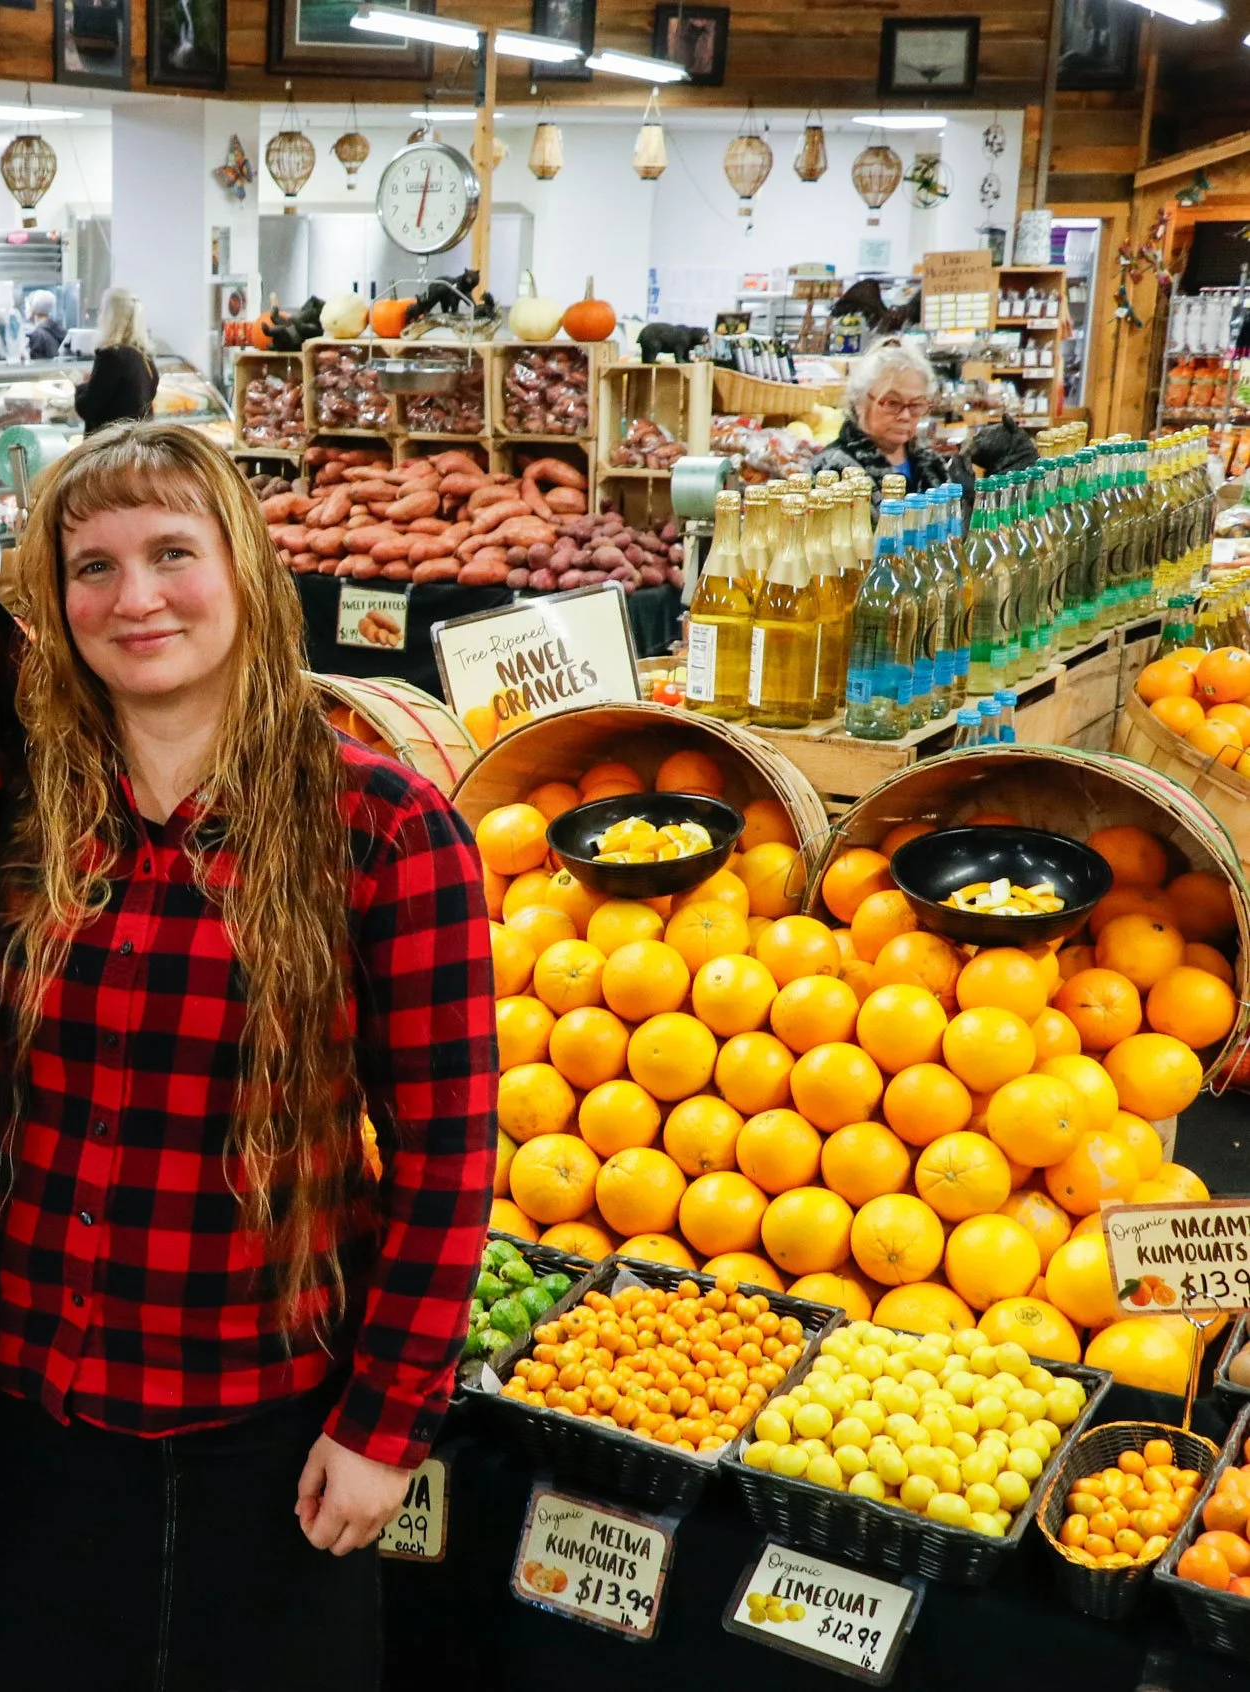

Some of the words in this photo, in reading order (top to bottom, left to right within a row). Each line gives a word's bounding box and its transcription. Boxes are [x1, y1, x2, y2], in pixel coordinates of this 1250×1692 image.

[402, 166, 410, 177] 9
[420, 159, 429, 171] 0
[438, 164, 443, 176] 1
[391, 184, 399, 195] 8
[449, 183, 457, 193] 2
[391, 204, 399, 216] 7
[449, 204, 457, 215] 3
[402, 223, 410, 233] 6
[420, 228, 427, 239] 5
[436, 221, 444, 232] 4
[341, 600, 365, 610] SWEET
[367, 600, 407, 611] POTATOES
[453, 648, 488, 671] Tree
[490, 617, 550, 660] Ripened
[495, 637, 574, 687] NAVEL
[492, 660, 598, 721] ORANGES
[1111, 1215, 1167, 1243] Organic
[1136, 1241, 1248, 1266] KUMQUATS
[537, 1507, 584, 1531] Organic
[395, 1540, 425, 1556] each
[590, 1520, 651, 1561] MEIWA
[545, 1533, 637, 1581] KUMQUATS
[768, 1552, 823, 1578] Organic
[575, 1572, 655, 1618] $13.99
[771, 1577, 883, 1619] LIMEQUAT
[817, 1613, 882, 1654] $12.99
